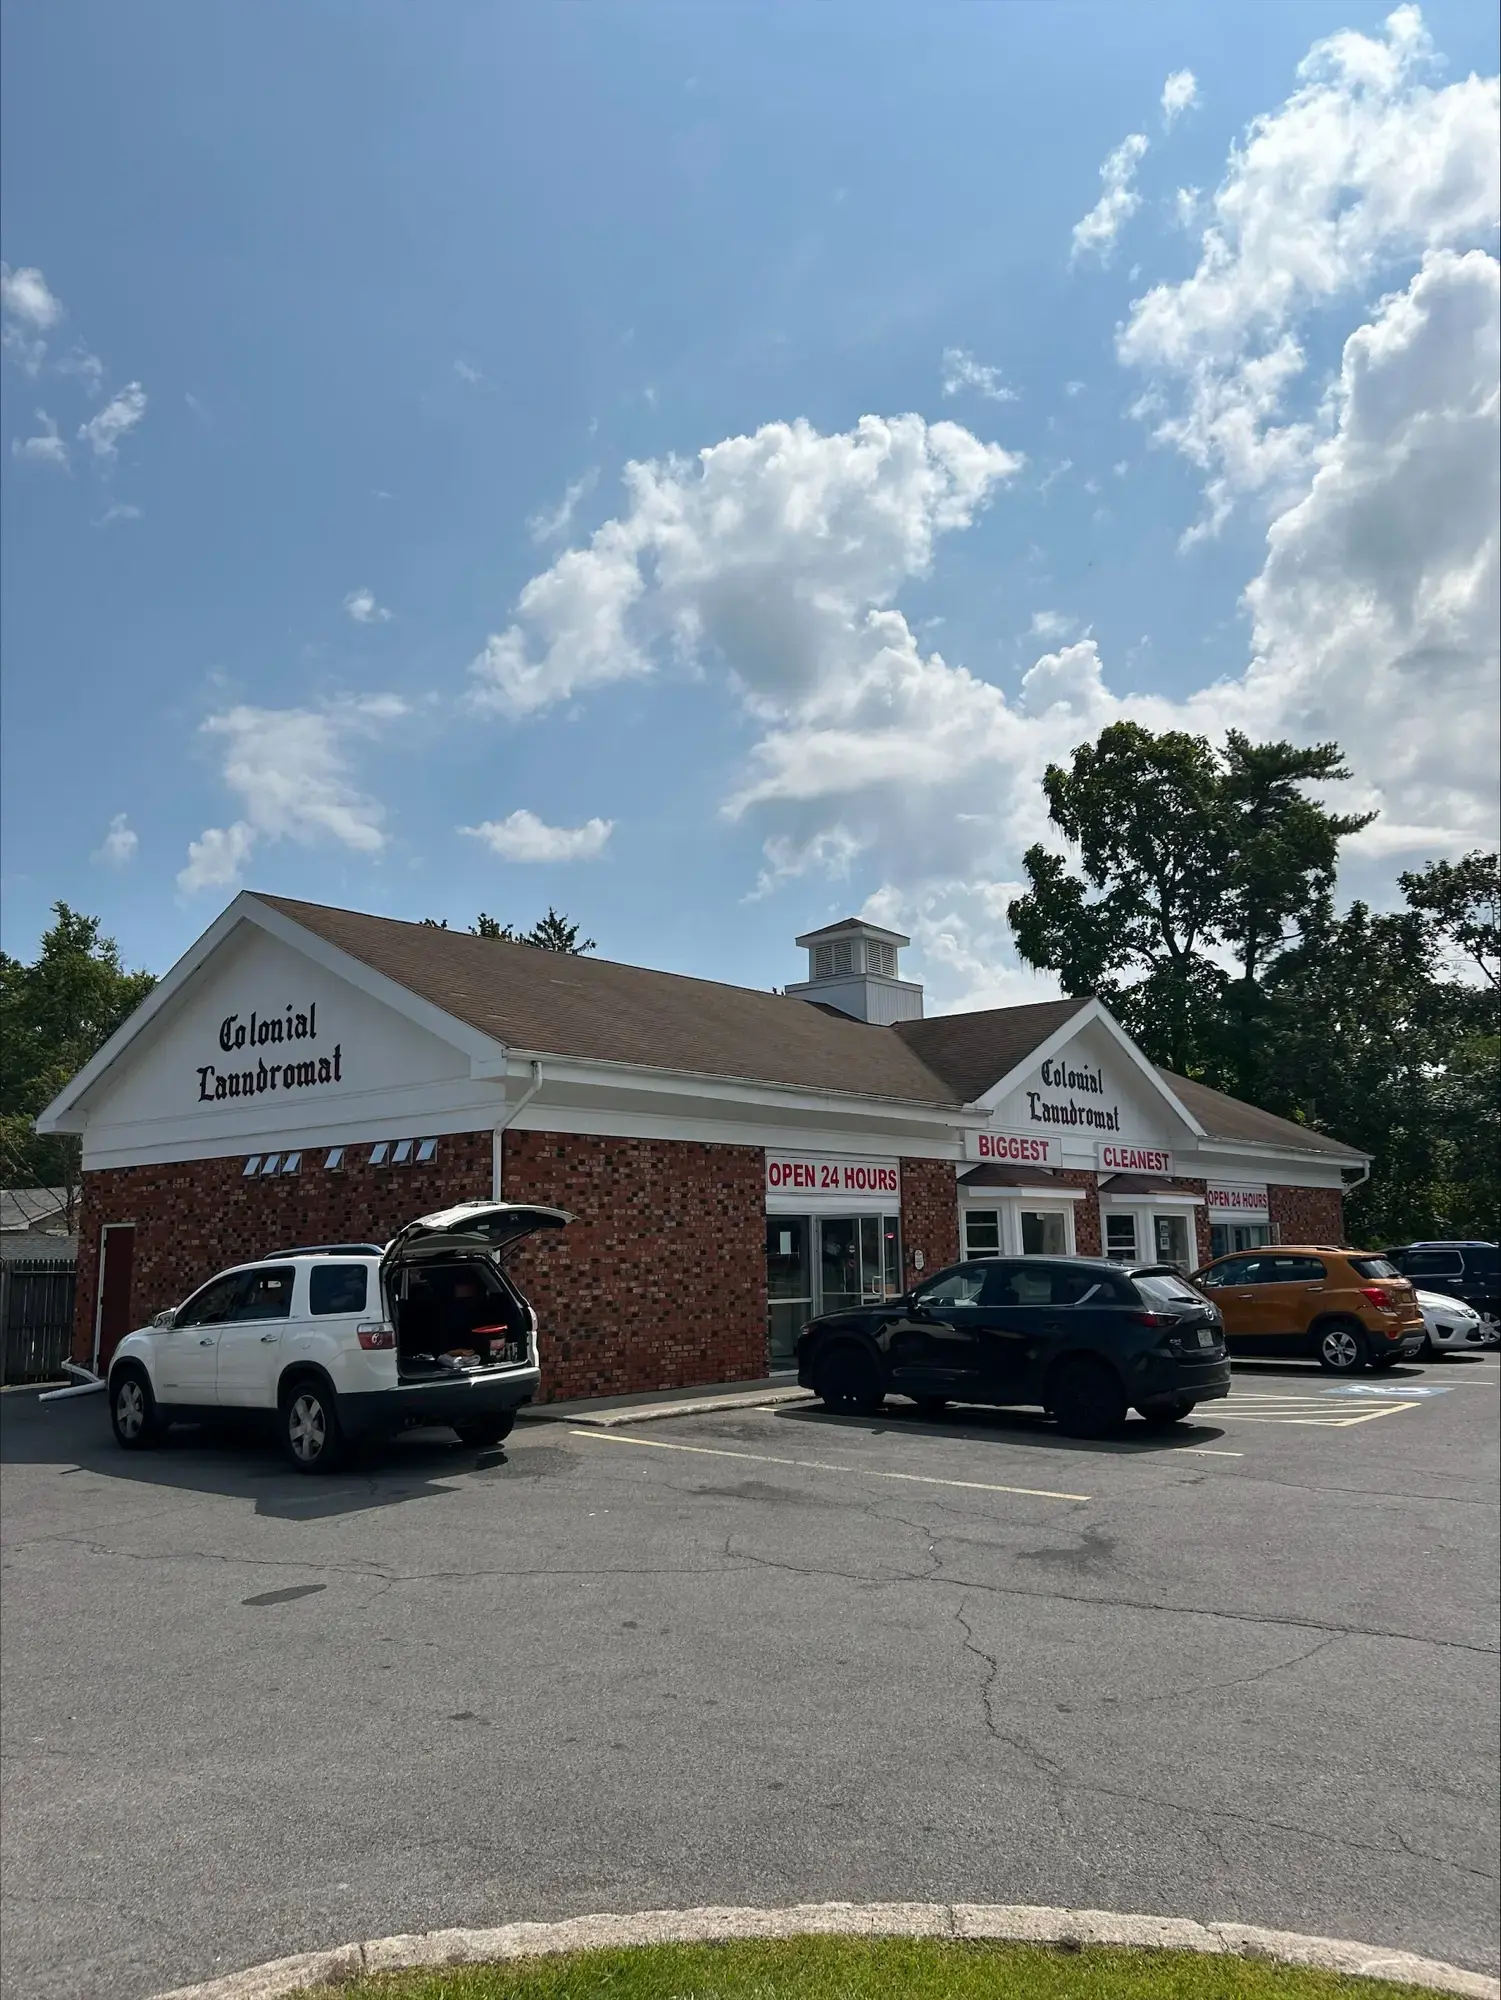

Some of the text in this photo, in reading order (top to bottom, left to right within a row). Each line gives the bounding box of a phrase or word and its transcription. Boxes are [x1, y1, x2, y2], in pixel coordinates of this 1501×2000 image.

[219, 1002, 317, 1052] Colonial
[196, 1043, 342, 1102] Laundromat
[1041, 1058, 1103, 1094] Colonial
[1026, 1091, 1120, 1131] Laundromat
[978, 1135, 1049, 1161] BIGGEST
[1103, 1147, 1169, 1171] CLEANEST
[768, 1162, 897, 1190] OPEN 24 HOURS
[1208, 1190, 1268, 1208] OPEN 24 HOURS
